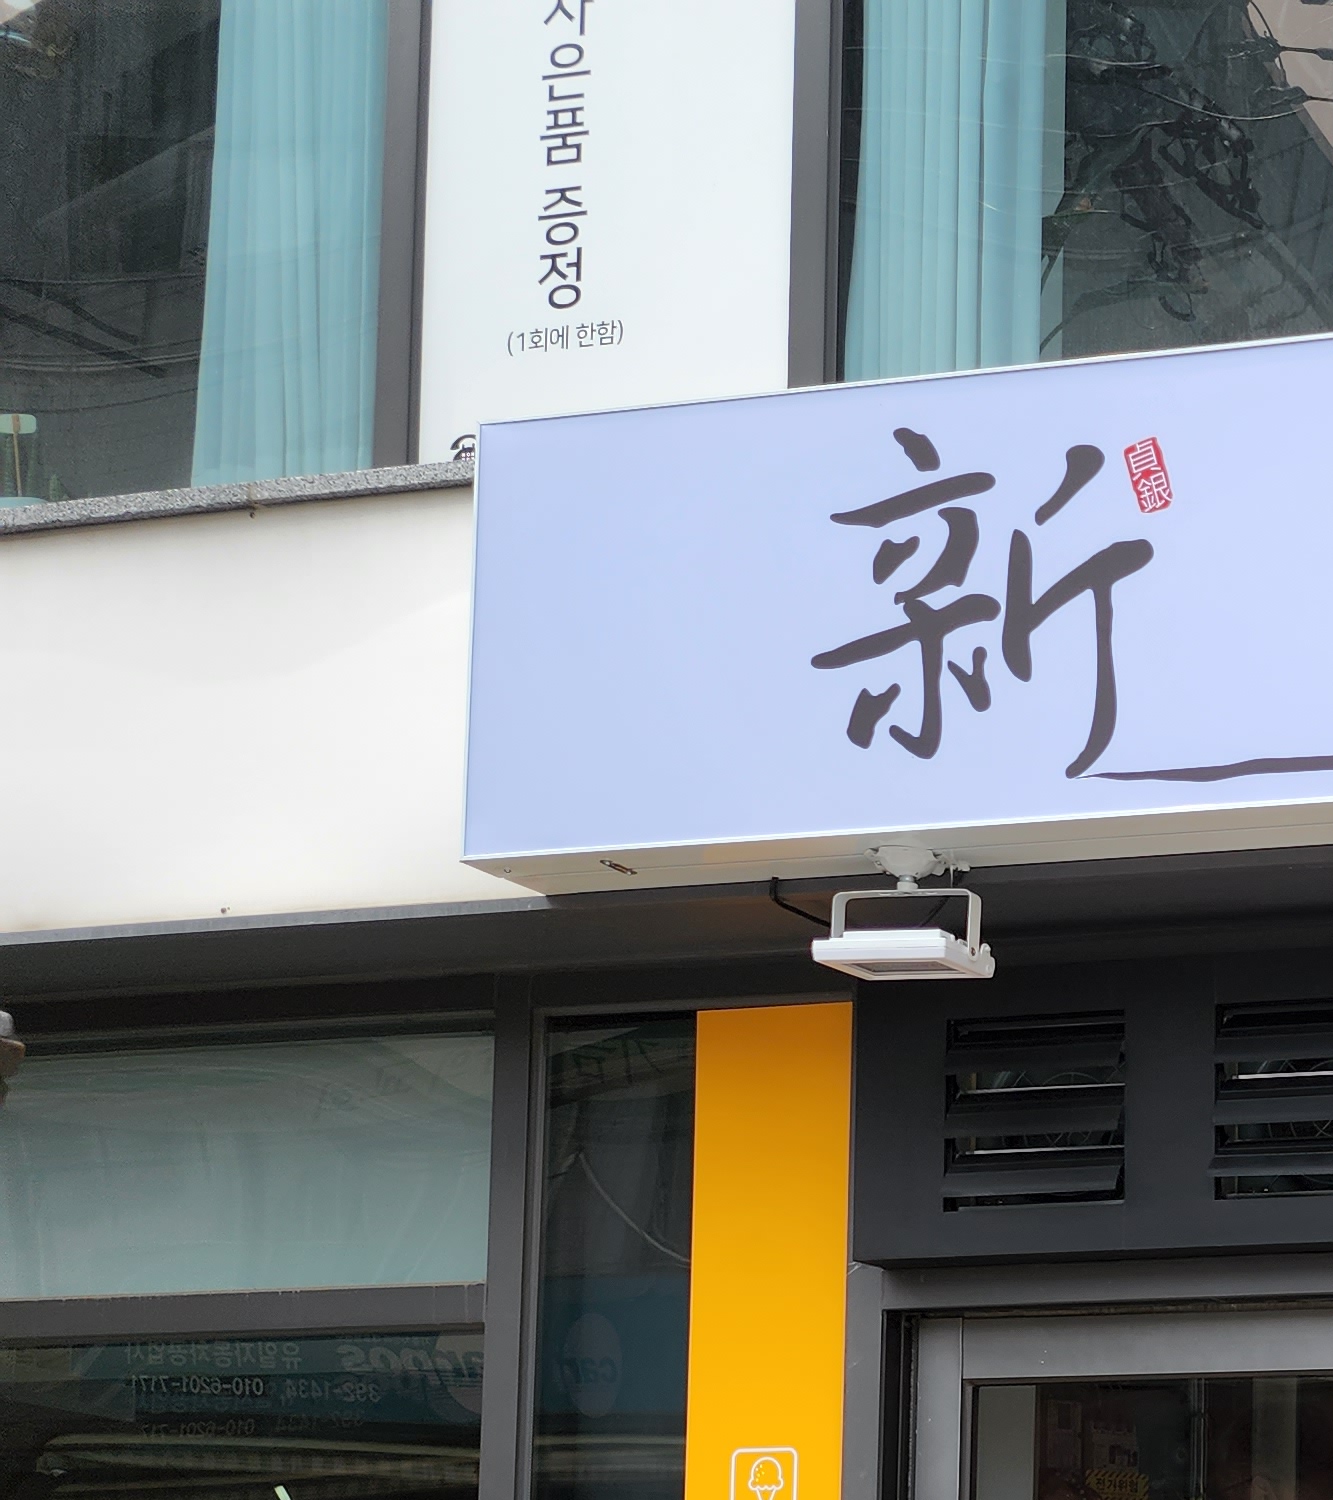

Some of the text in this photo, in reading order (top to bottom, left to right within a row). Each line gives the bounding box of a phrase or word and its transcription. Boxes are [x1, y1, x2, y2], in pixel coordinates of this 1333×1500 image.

[537, 185, 589, 310] 증정
[506, 319, 625, 357] (1회에 한함)
[810, 427, 1155, 780] 新
